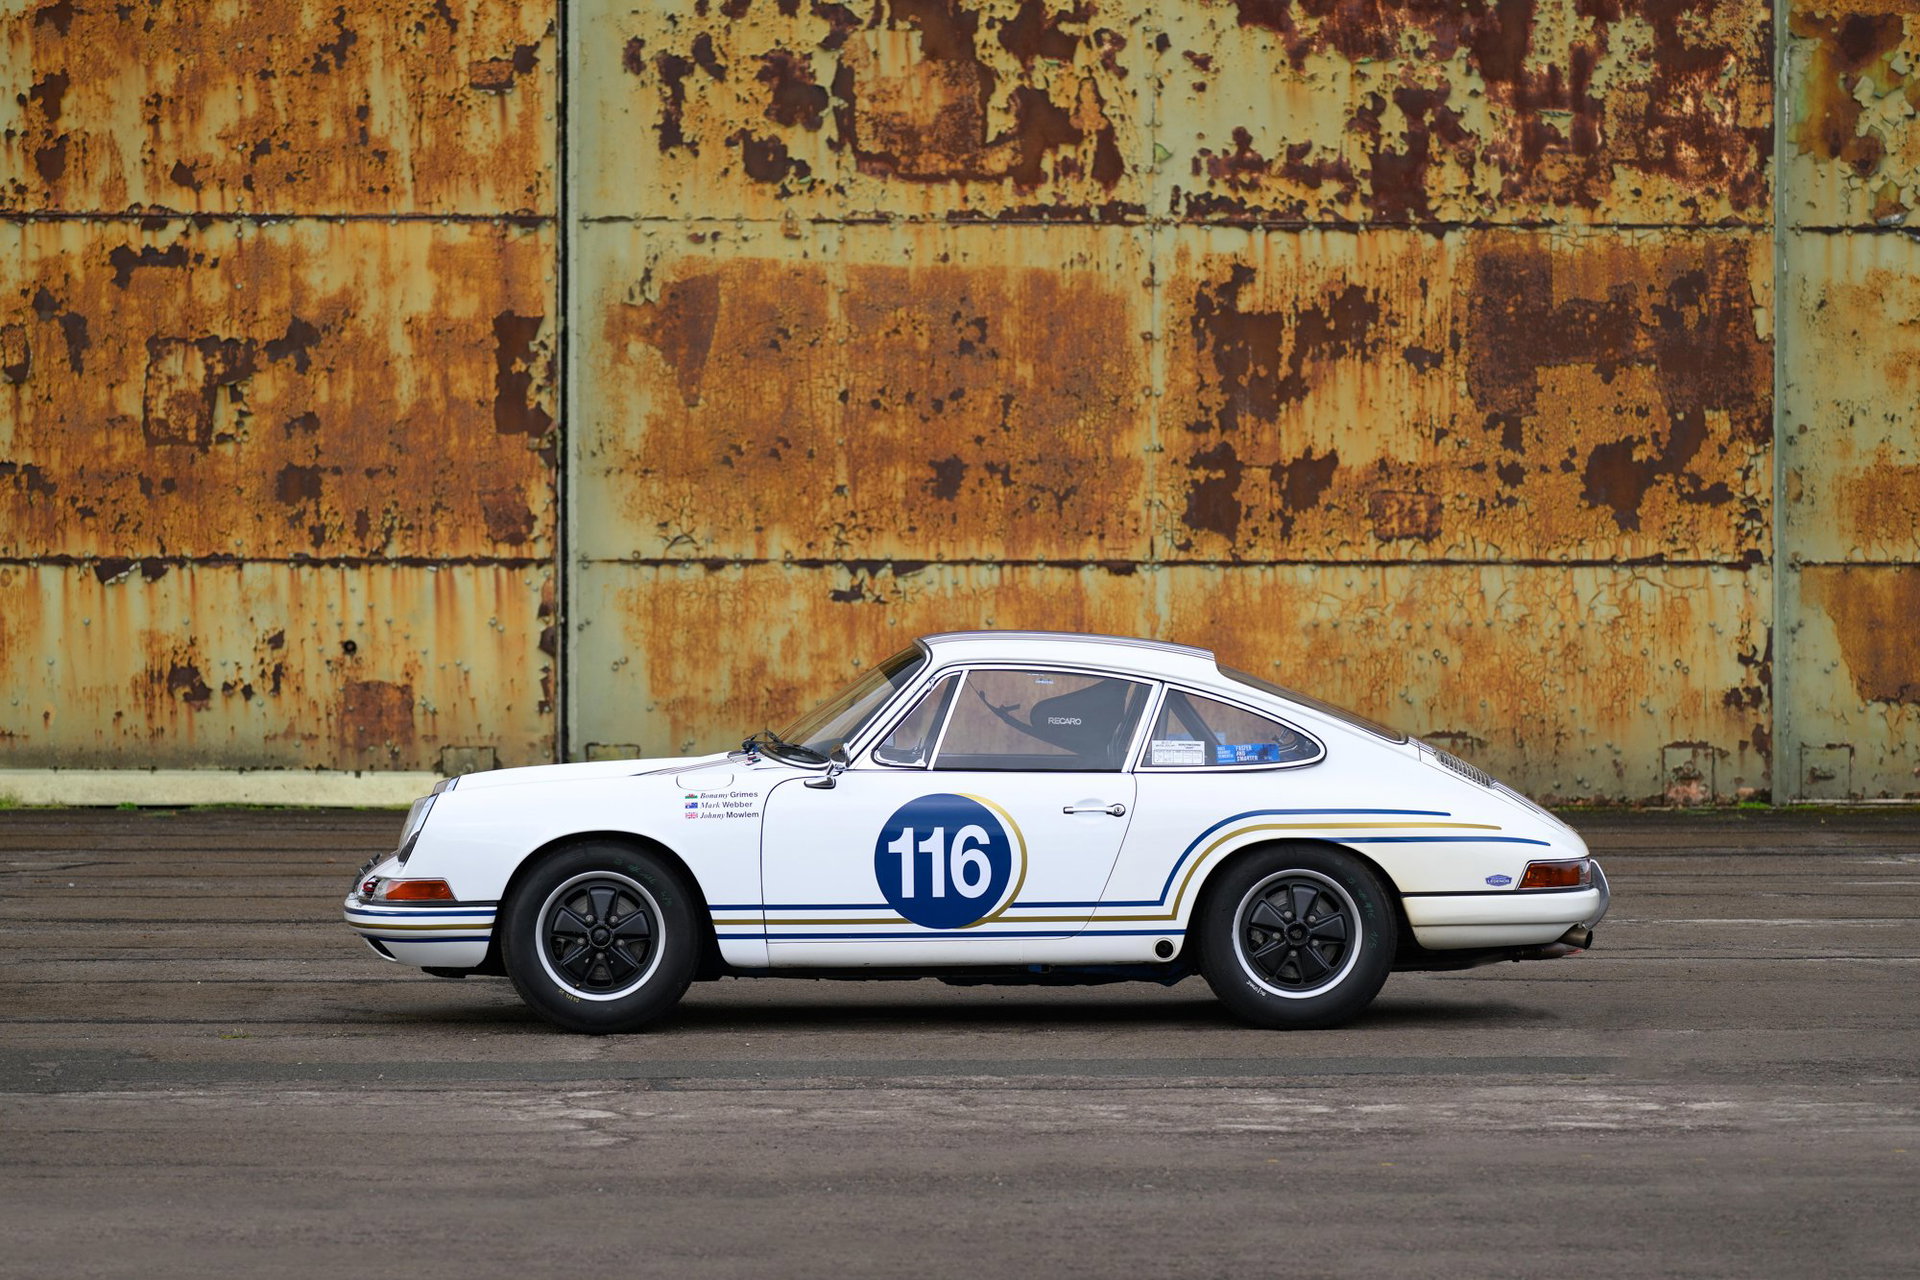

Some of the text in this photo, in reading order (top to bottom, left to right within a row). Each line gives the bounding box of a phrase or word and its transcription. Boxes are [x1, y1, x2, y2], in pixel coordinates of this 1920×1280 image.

[1047, 716, 1082, 726] RECARO
[701, 801, 720, 809] Mark
[700, 811, 726, 820] Johnny
[888, 824, 992, 899] 116
